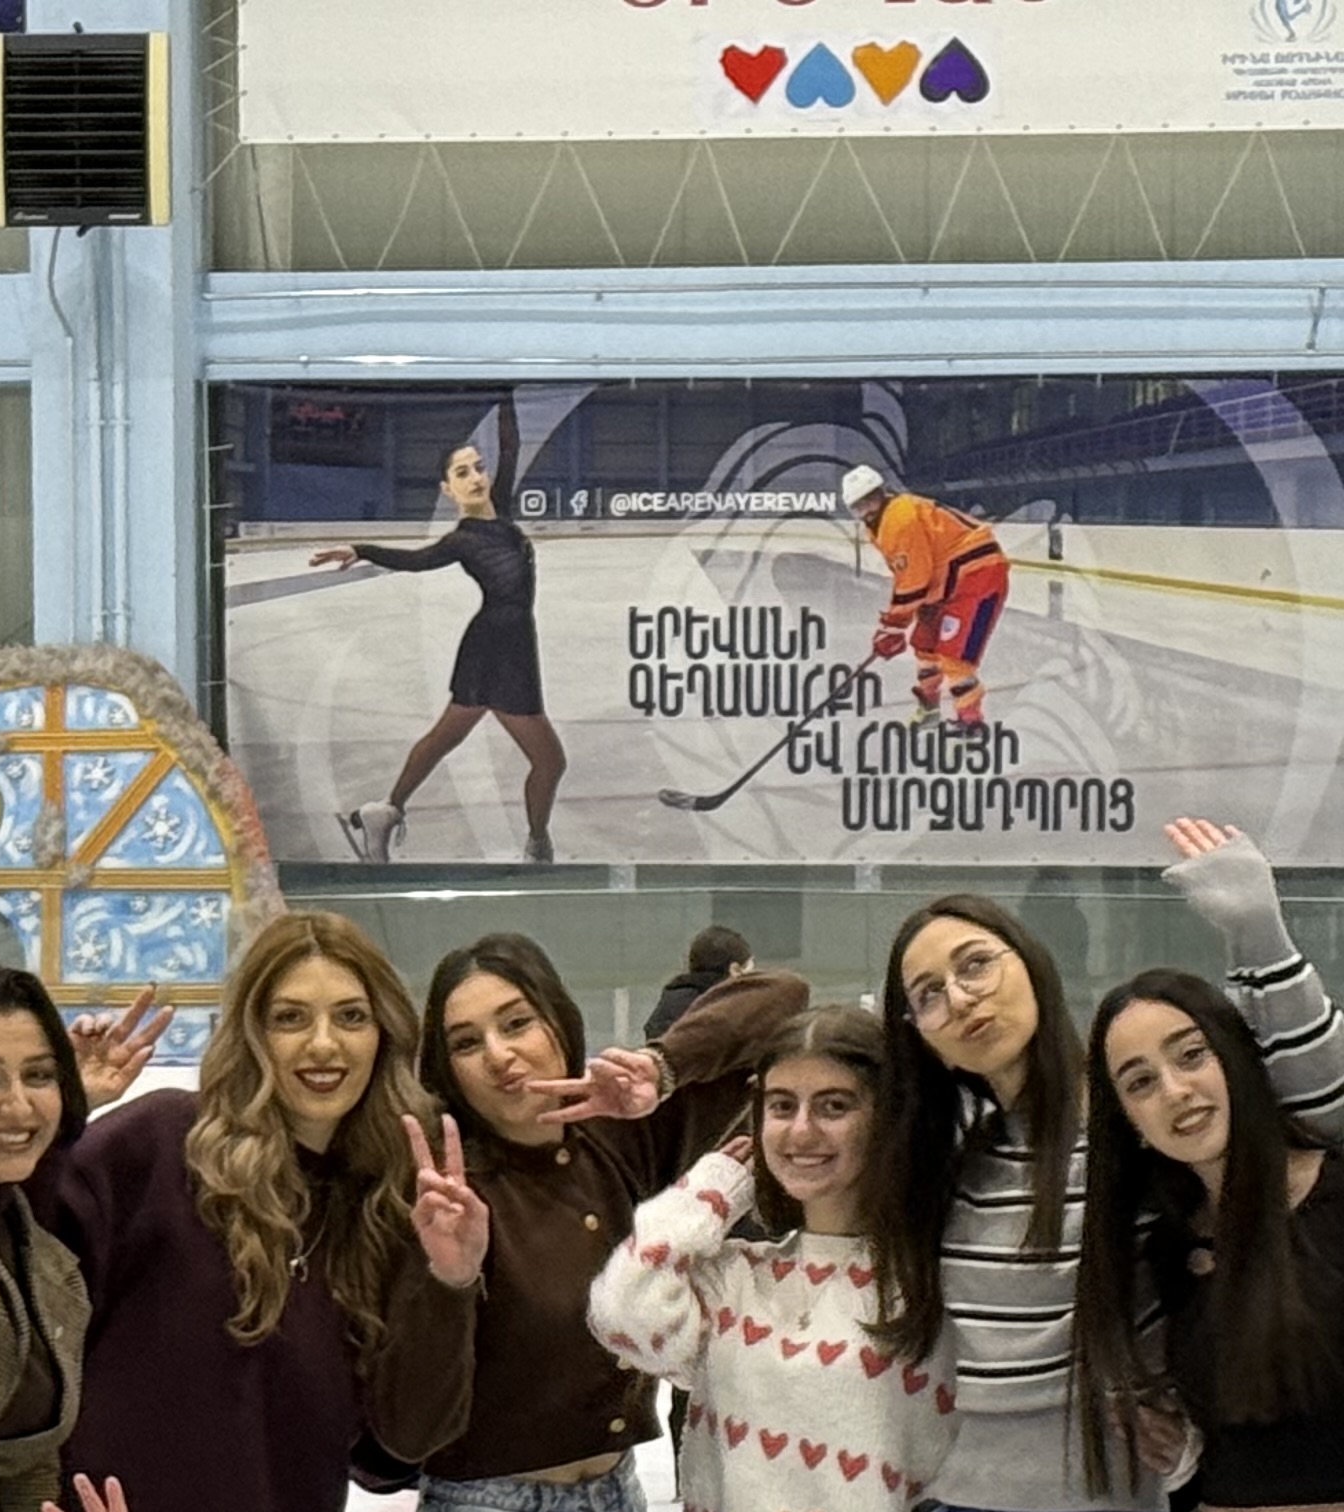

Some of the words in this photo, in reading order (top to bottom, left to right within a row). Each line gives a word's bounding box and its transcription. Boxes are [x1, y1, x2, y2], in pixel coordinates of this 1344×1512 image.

[610, 492, 836, 516] @ICEARENAYEREVAN
[628, 606, 826, 660] ԵՐԵՎԱՆԻ
[842, 778, 1135, 832] ՄԱՐԶԱԴՊՐՈՑ
